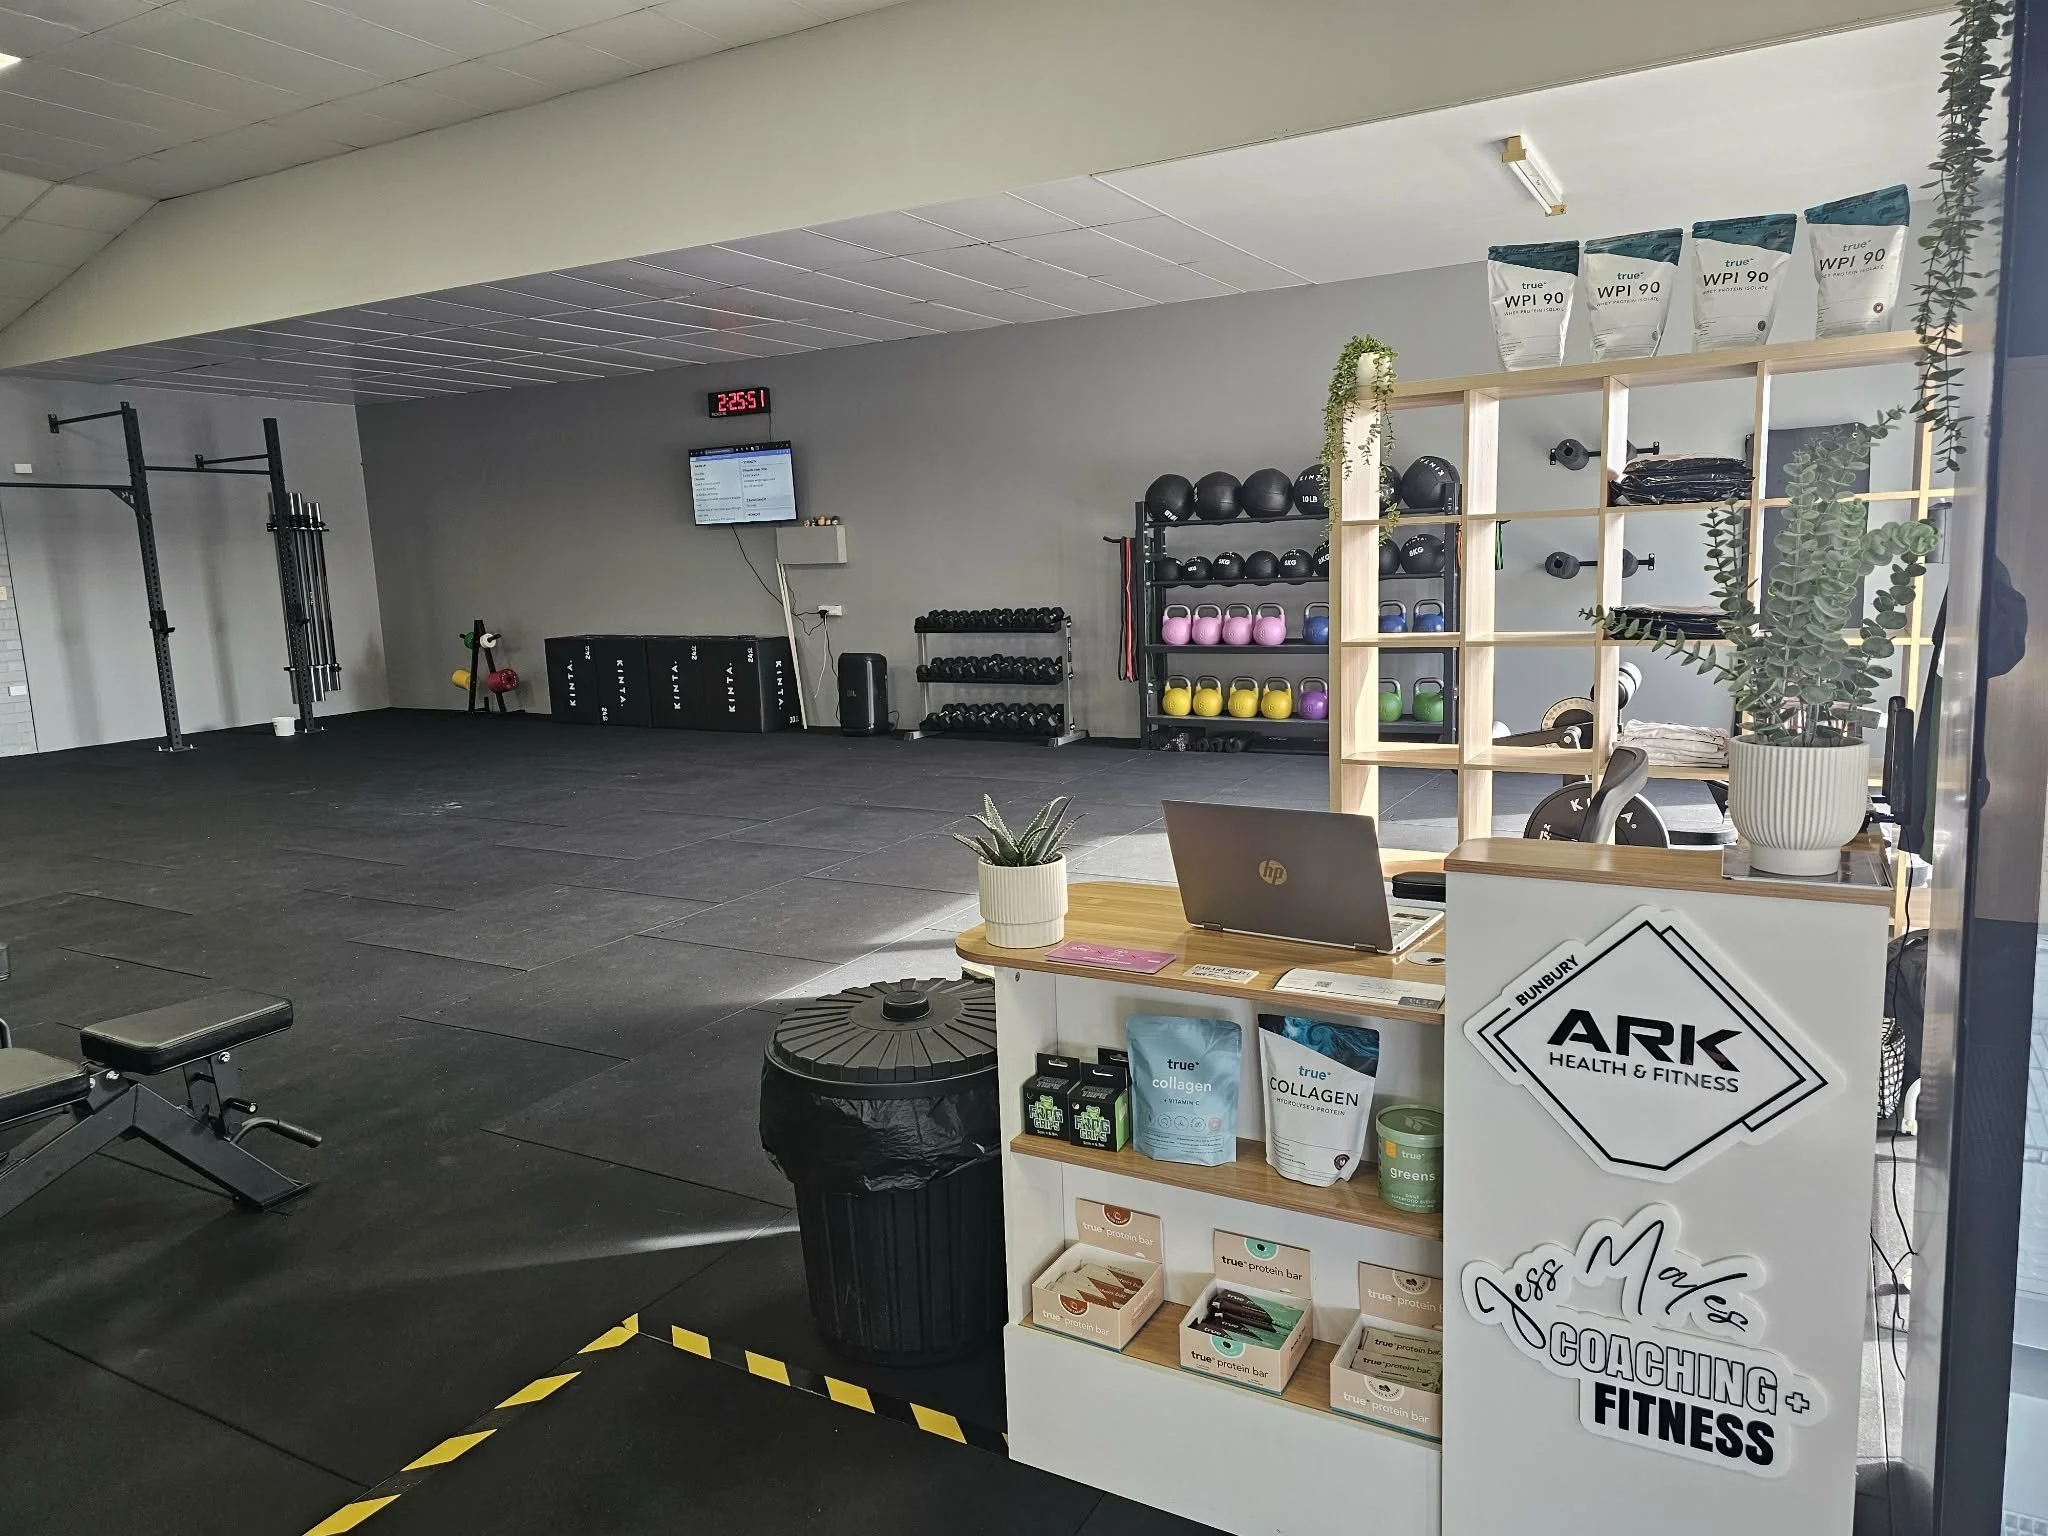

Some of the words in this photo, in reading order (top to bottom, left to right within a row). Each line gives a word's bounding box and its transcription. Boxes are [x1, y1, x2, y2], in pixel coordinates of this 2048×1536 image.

[1819, 255, 1855, 272] WPI
[1863, 248, 1886, 265] 90
[1702, 272, 1739, 287] WPI
[1746, 270, 1769, 283] 90
[1597, 284, 1631, 299] WPI
[1638, 281, 1661, 295] 90
[1504, 293, 1537, 309] WPI
[1543, 292, 1564, 304] 90
[717, 389, 765, 412] 2:25:51
[1263, 861, 1284, 884] hp
[1515, 954, 1580, 1008] BUNBURY
[1546, 1008, 1743, 1073] ARK
[1549, 1051, 1627, 1077] HEALTH
[1632, 1064, 1647, 1079] &
[1653, 1067, 1739, 1094] FITNESS
[1152, 1076, 1212, 1094] collagen
[1269, 1076, 1359, 1107] COLLAGEN
[1168, 1098, 1194, 1106] VITAMIN
[1276, 1097, 1315, 1111] HYDROLYSED
[1316, 1106, 1346, 1116] PROTEIN
[1033, 1117, 1061, 1131] GRIPS
[1390, 1167, 1436, 1181] greens
[1106, 1228, 1138, 1243] protein
[1138, 1234, 1155, 1246] bar
[1248, 1262, 1284, 1276] protein
[1286, 1268, 1303, 1281] bar
[1397, 1297, 1437, 1312] protein
[1474, 1258, 1563, 1350] Jess
[1064, 1318, 1094, 1331] protein
[1095, 1324, 1110, 1337] bar
[1395, 1343, 1425, 1355] protein
[1217, 1358, 1250, 1374] protein
[1252, 1366, 1269, 1379] bar
[1384, 1361, 1415, 1372] protein
[1549, 1321, 1778, 1416] COACHING
[1785, 1391, 1810, 1415] +
[1371, 1400, 1409, 1419] protein
[1411, 1409, 1429, 1424] bar
[1593, 1381, 1775, 1466] FITNESS
